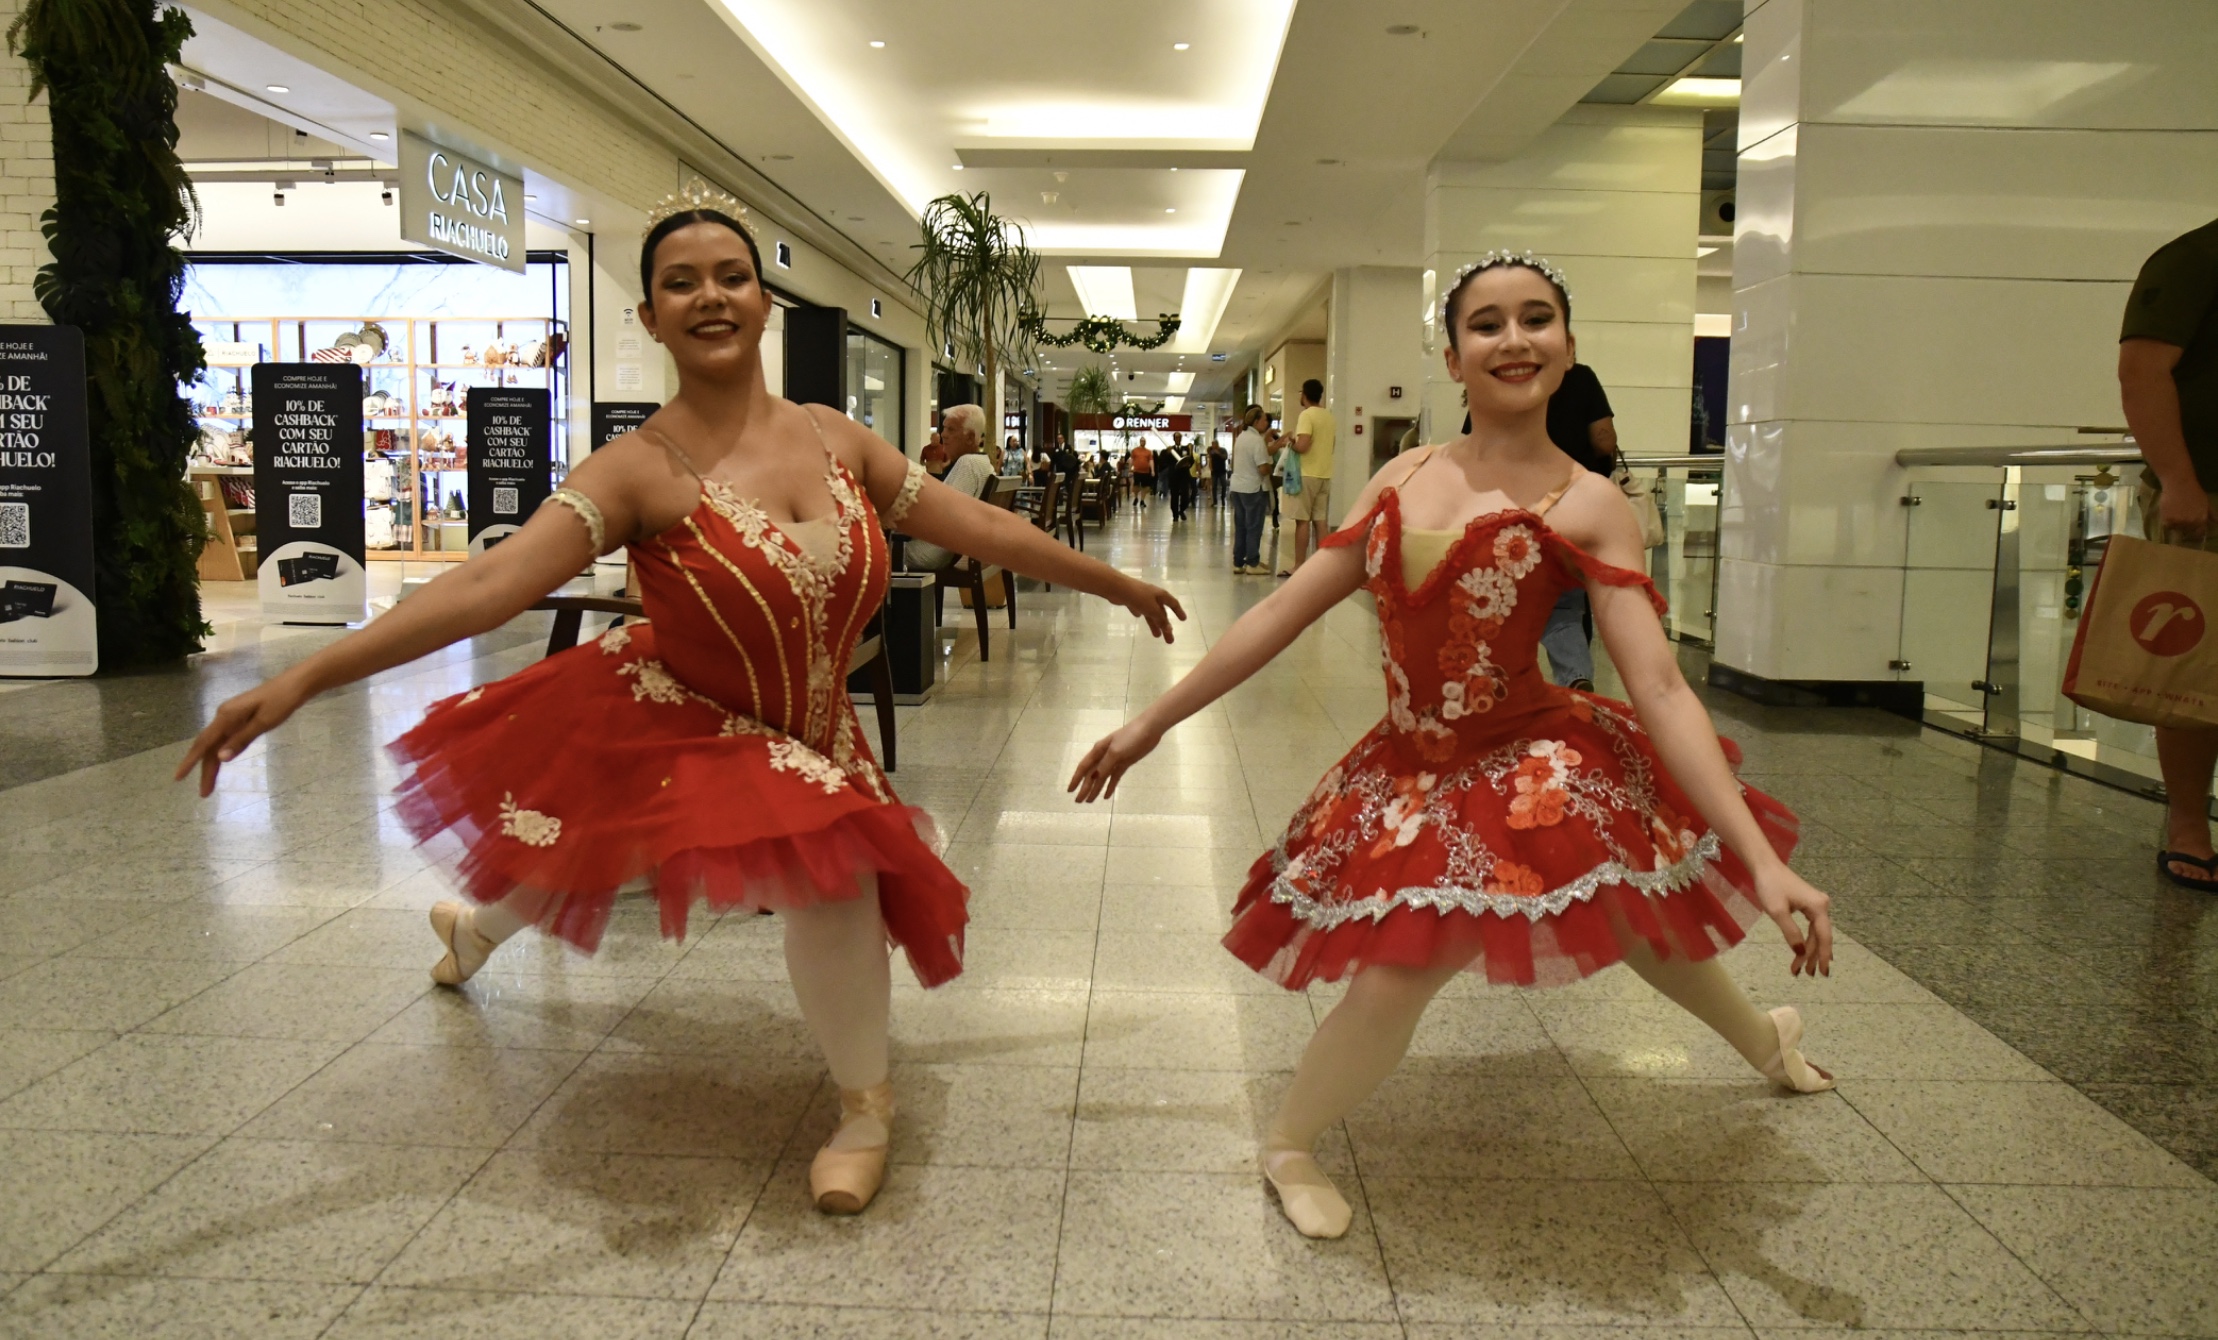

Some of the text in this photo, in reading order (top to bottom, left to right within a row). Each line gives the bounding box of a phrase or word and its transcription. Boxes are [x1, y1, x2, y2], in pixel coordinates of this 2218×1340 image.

[428, 153, 507, 225] CASA
[429, 211, 509, 261] RIACHUELO
[6, 342, 28, 350] HOJE
[28, 342, 34, 350] E
[7, 352, 48, 360] AMANHÃ!
[7, 375, 31, 391] DE
[286, 400, 325, 412] 10% DE
[10, 413, 44, 430] SEU
[492, 415, 522, 425] 10% DE
[1126, 417, 1169, 428] RENNER
[279, 427, 333, 441] COM SEU
[282, 440, 330, 455] CARTÃO
[487, 437, 528, 447] COM SEU
[488, 447, 525, 458] CARTÃO
[273, 456, 341, 469] RIACHUELO!
[482, 458, 534, 469] RIACHUELO!
